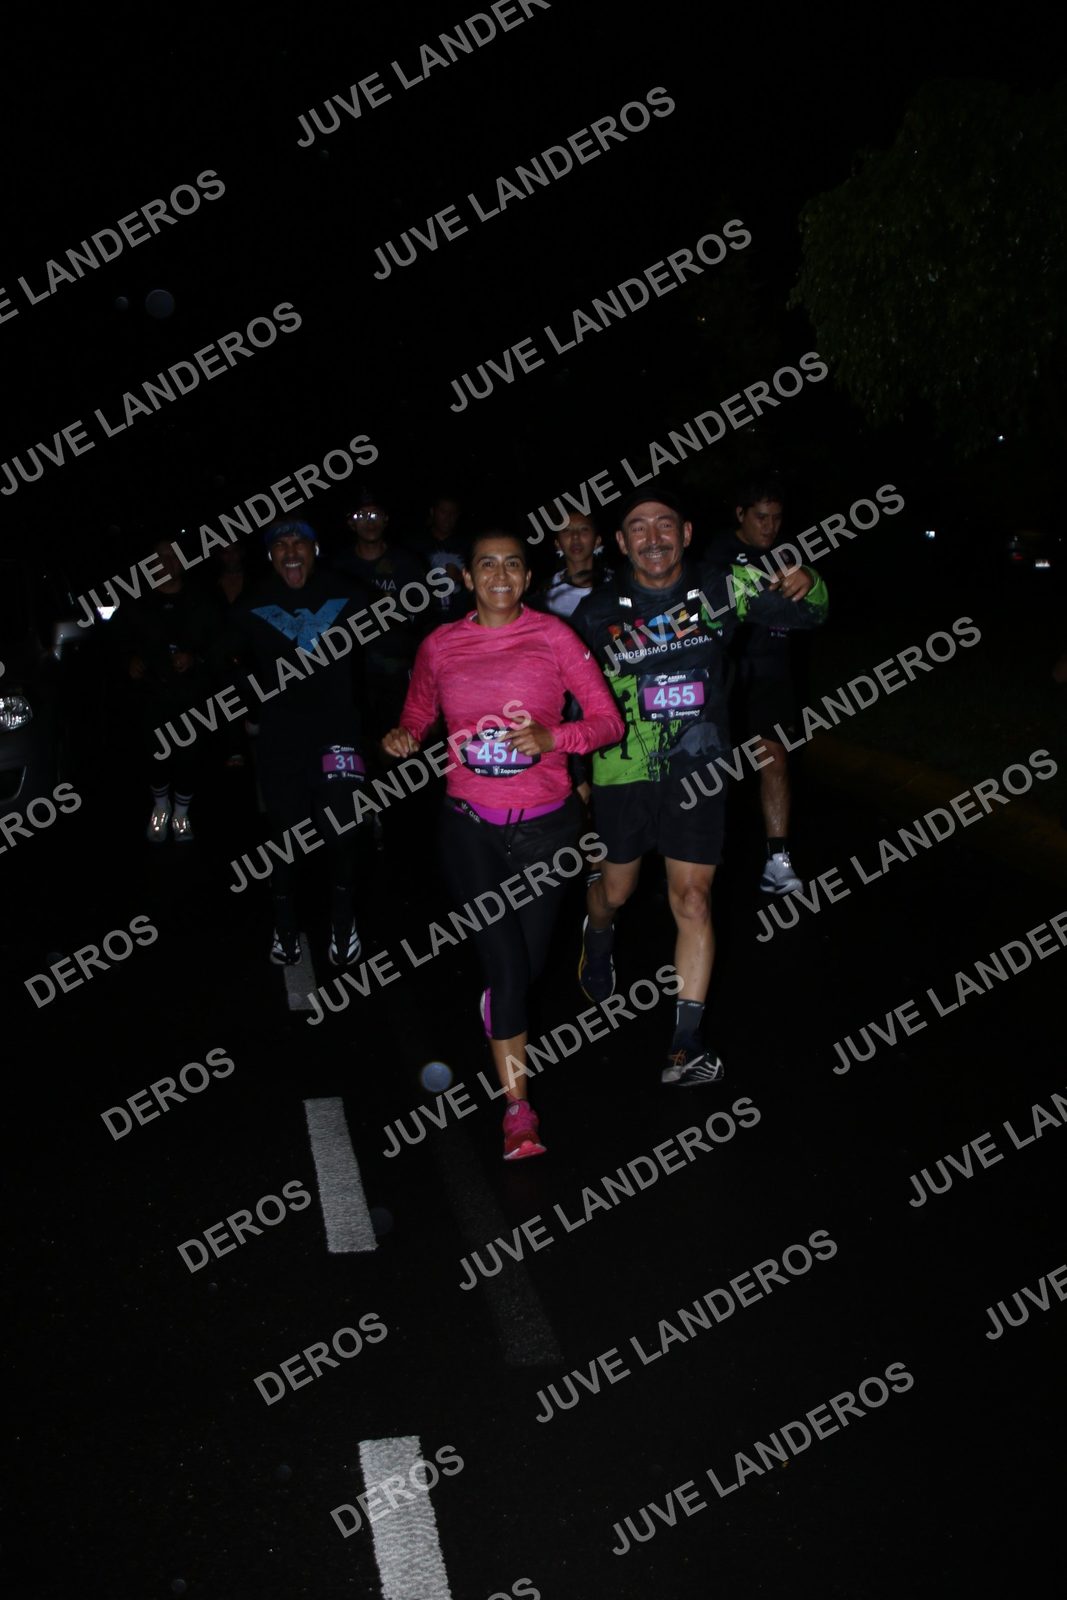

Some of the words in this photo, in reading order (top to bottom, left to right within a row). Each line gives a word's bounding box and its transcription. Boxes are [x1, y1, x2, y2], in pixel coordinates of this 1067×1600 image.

[670, 641, 682, 651] DE
[653, 685, 696, 707] 455
[477, 742, 518, 763] 457
[335, 754, 355, 770] 31
